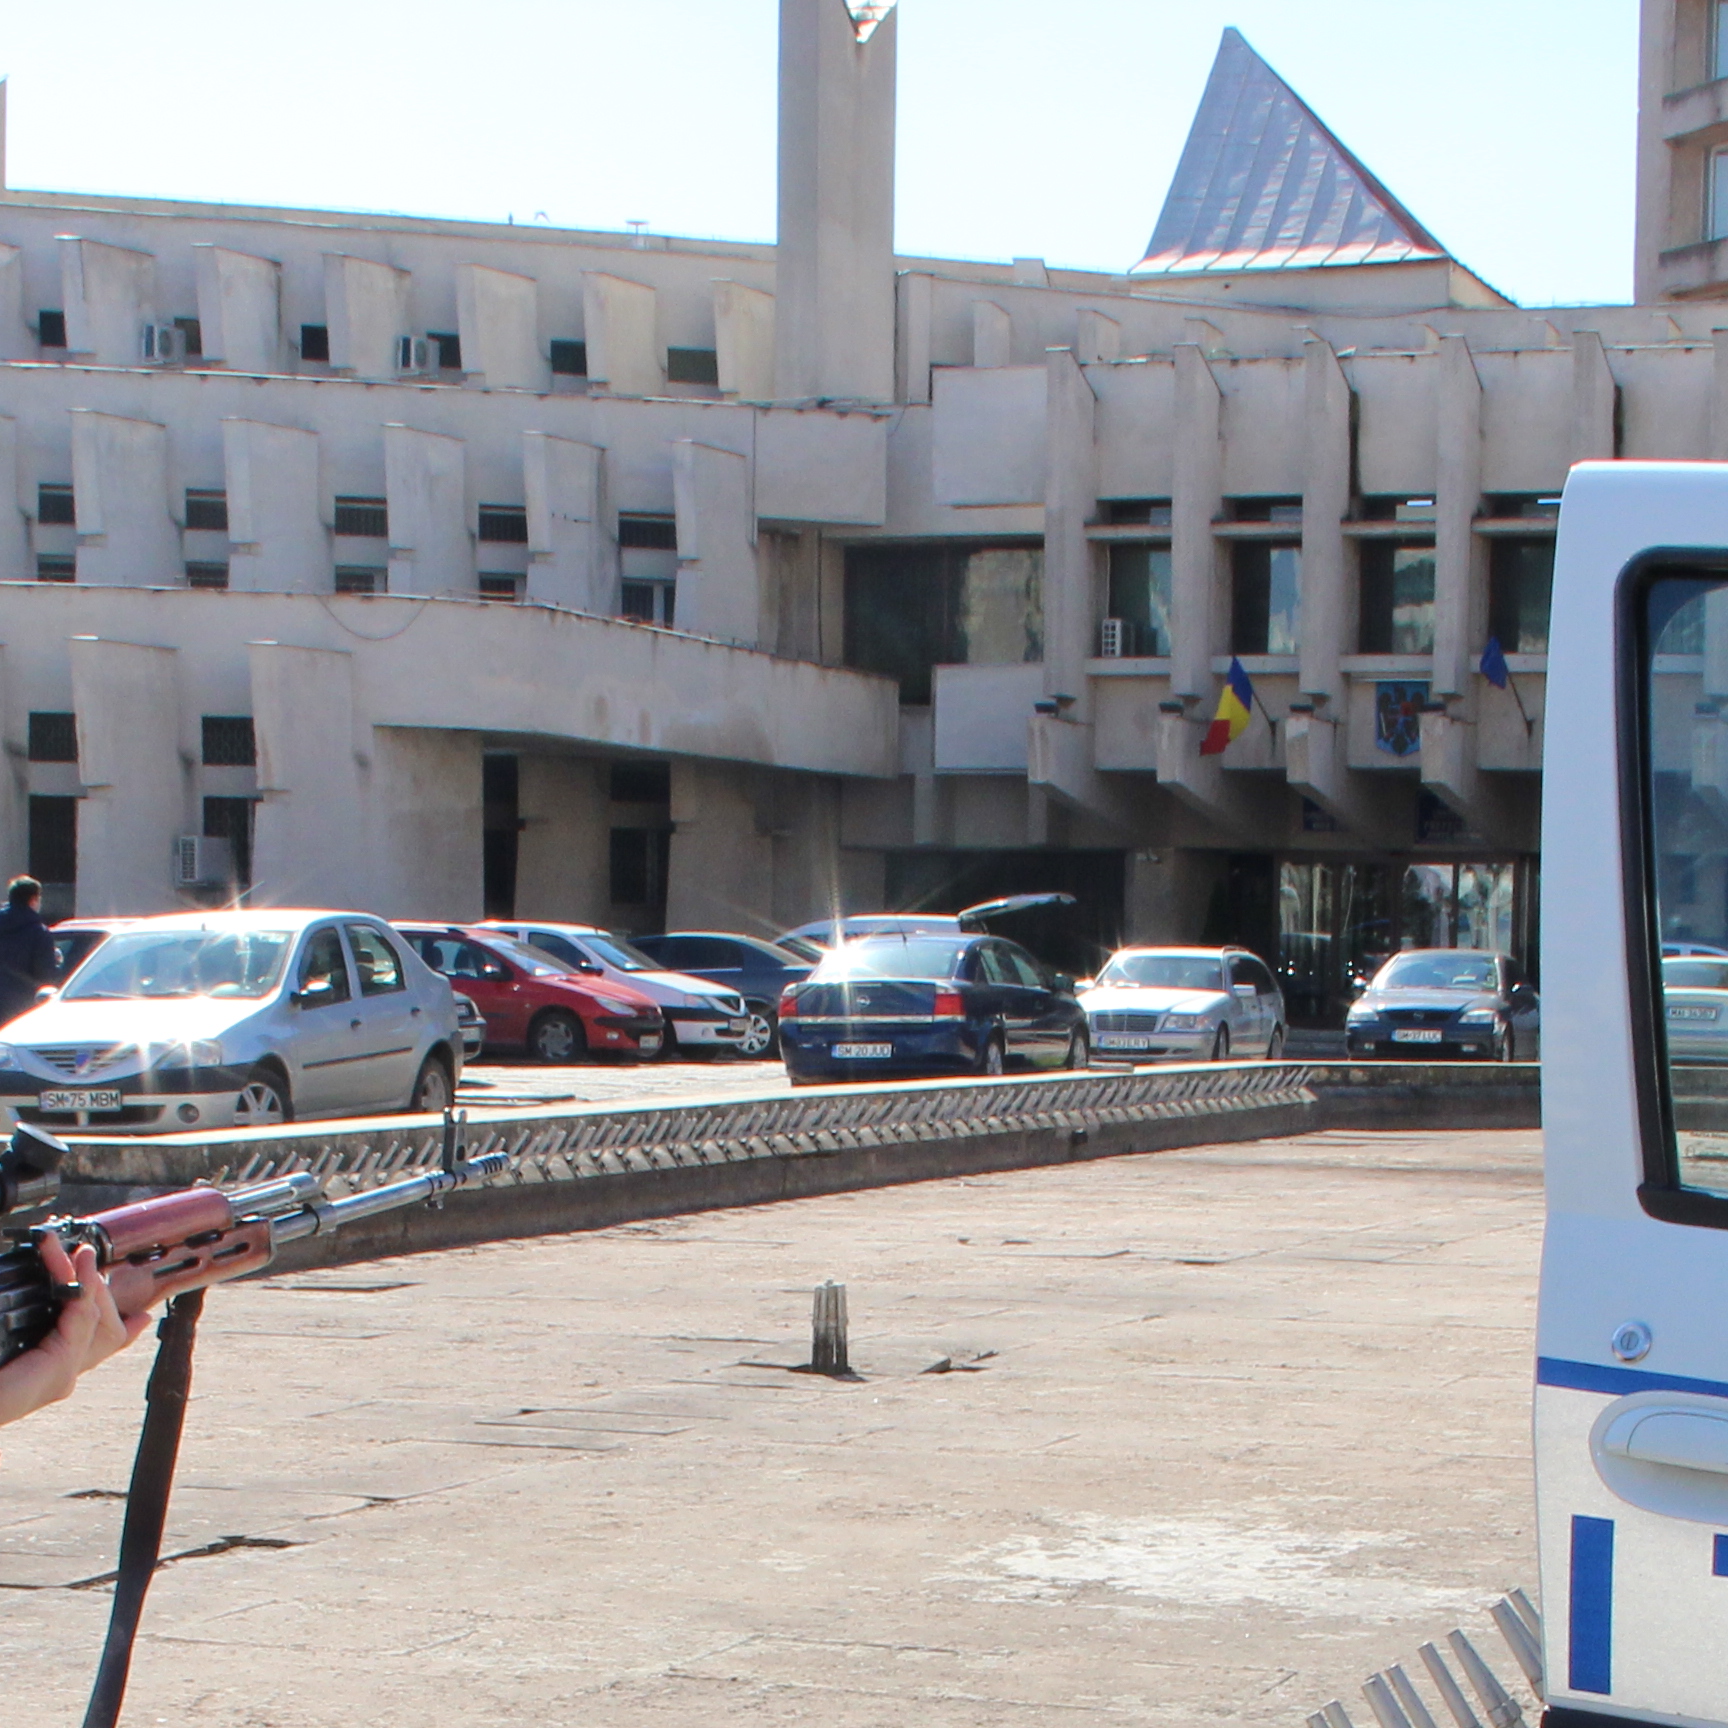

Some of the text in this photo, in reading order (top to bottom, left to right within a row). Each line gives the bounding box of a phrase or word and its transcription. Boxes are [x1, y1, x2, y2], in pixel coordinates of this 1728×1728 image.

[48, 1091, 119, 1108] SM 75 MBM
